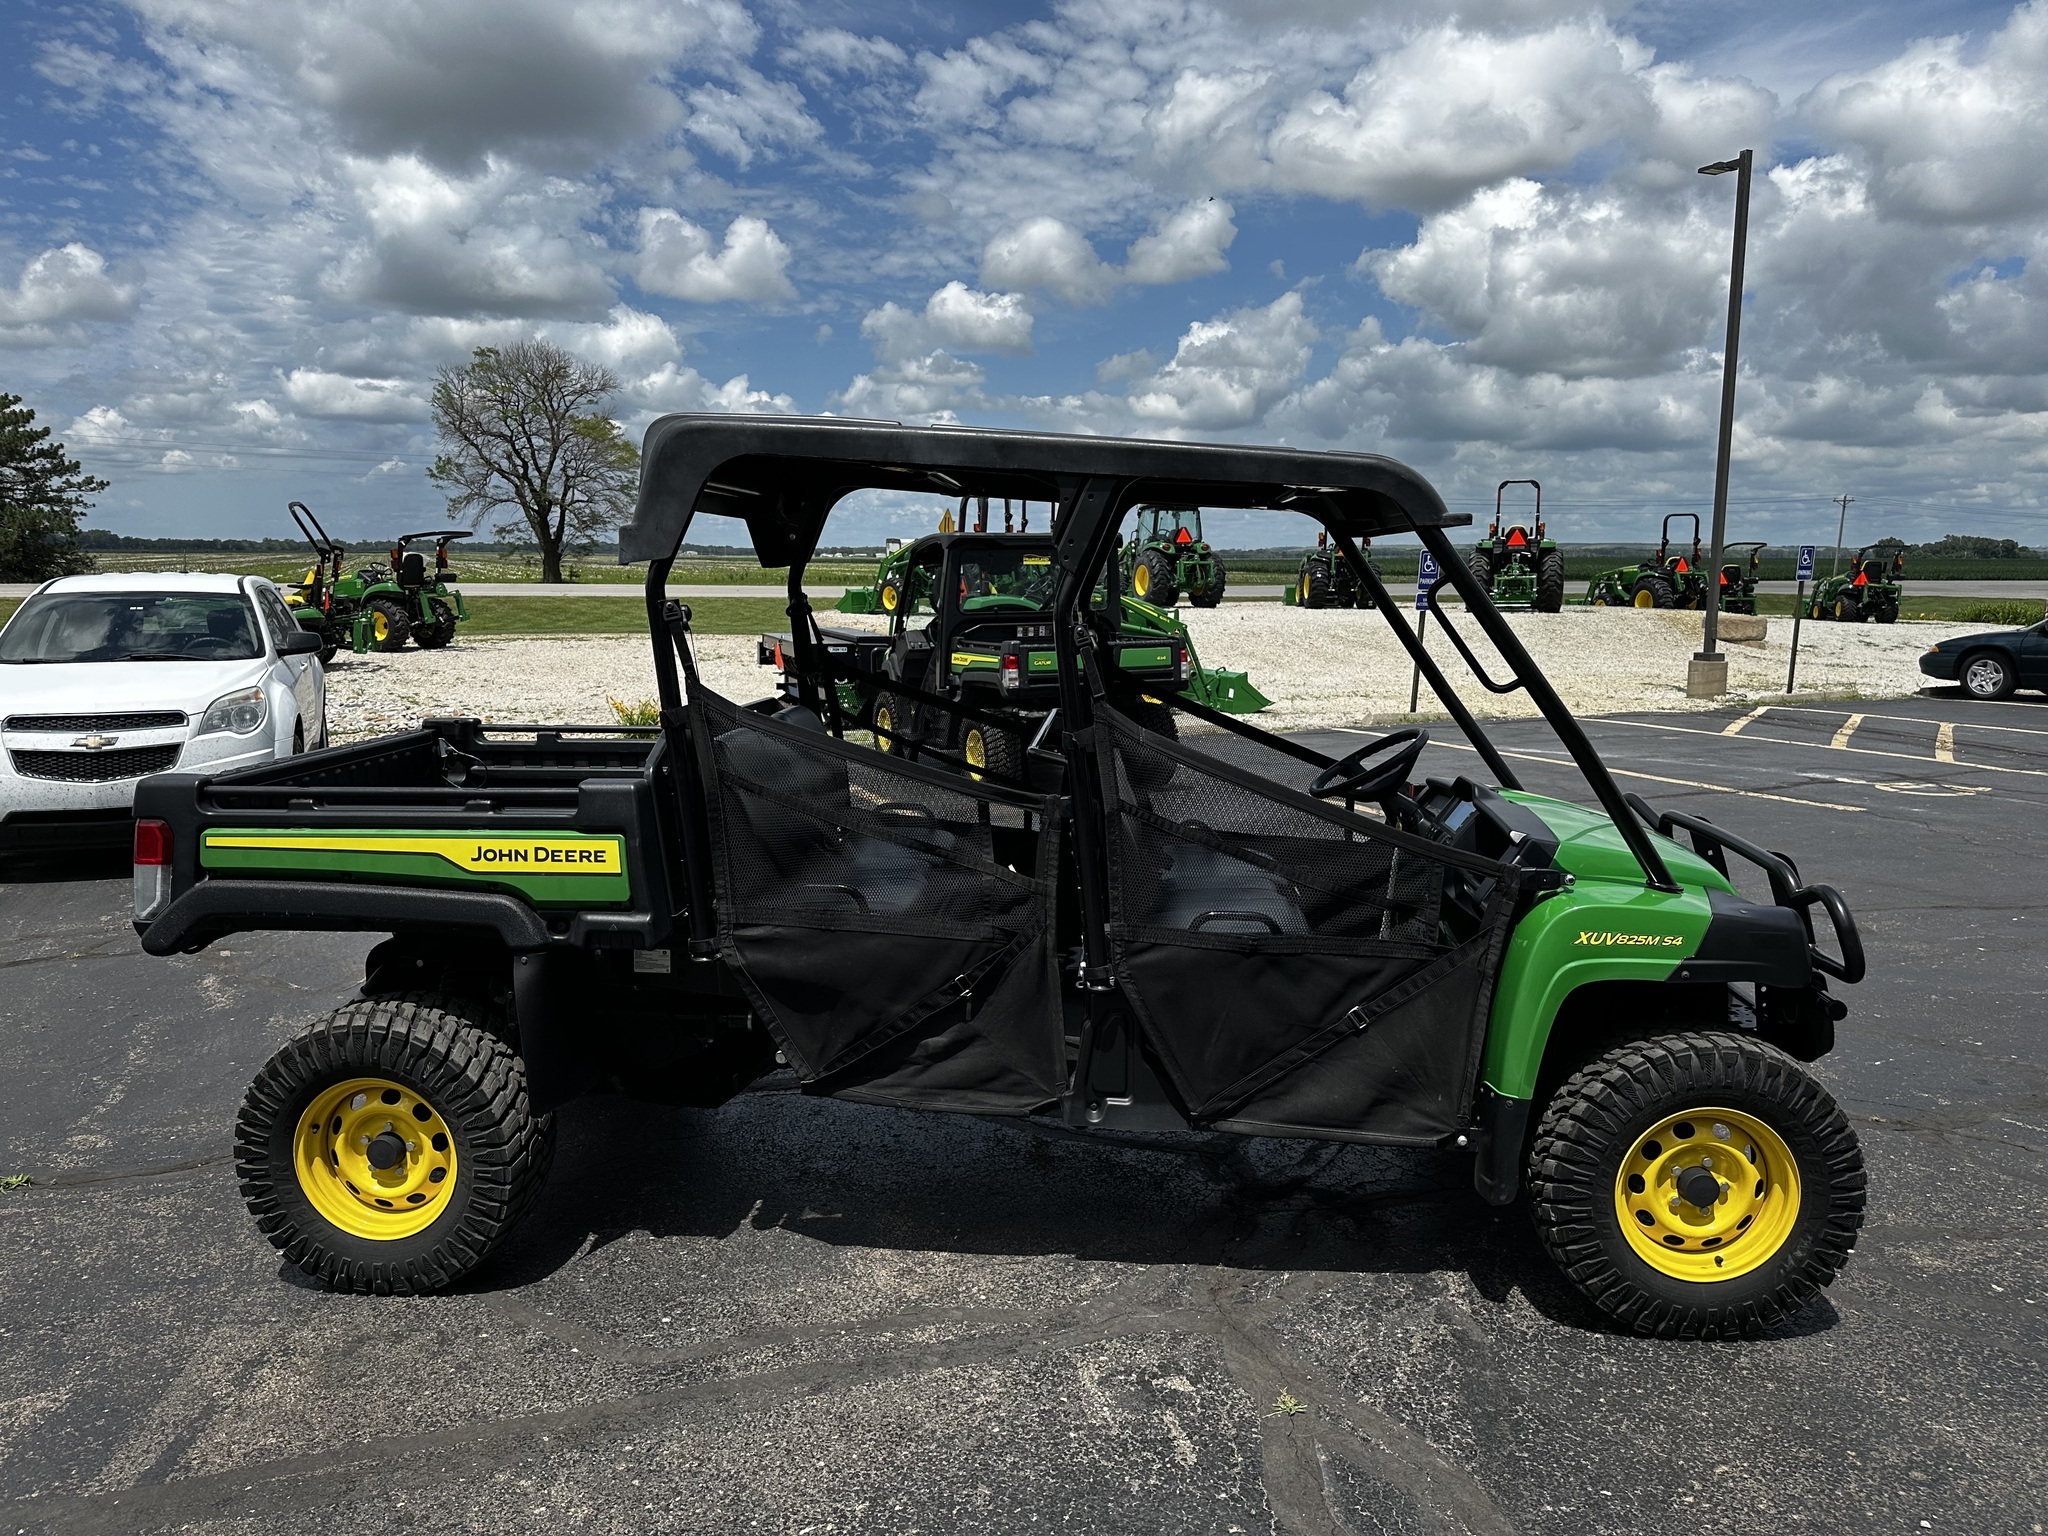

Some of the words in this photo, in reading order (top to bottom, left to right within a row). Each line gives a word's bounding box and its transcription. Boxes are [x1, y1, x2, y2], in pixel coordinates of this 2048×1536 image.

[471, 846, 528, 862] JOHN
[534, 847, 606, 863] DEERE
[1574, 931, 1660, 946] XUV825M
[1662, 936, 1683, 946] S4
